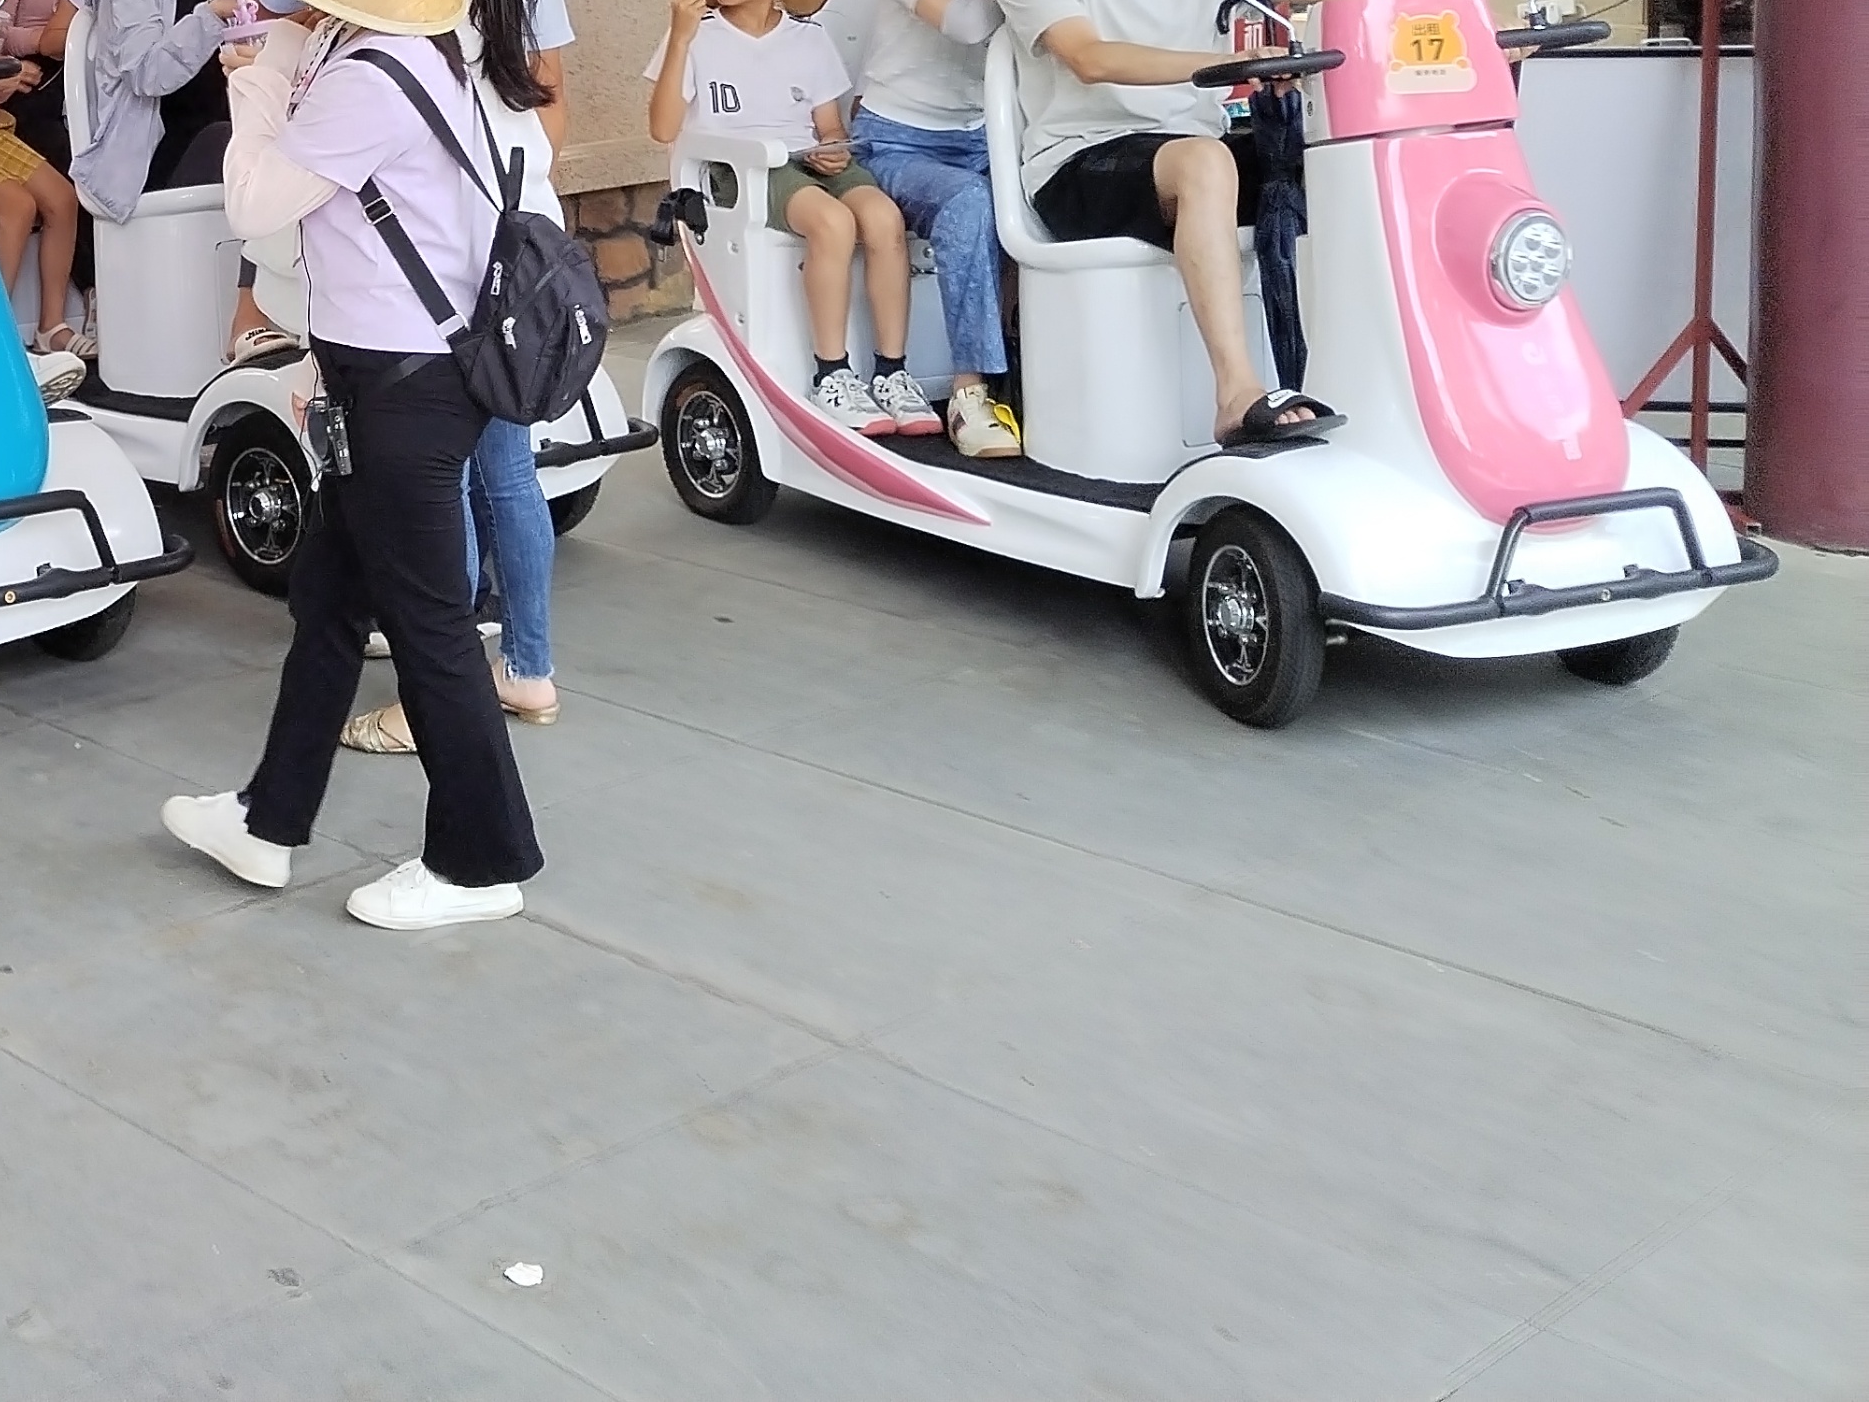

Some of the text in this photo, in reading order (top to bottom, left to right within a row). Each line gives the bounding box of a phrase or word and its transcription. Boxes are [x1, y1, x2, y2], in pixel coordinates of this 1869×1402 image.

[1411, 22, 1441, 36] 出租
[1409, 37, 1445, 62] 17
[708, 81, 741, 114] 10
